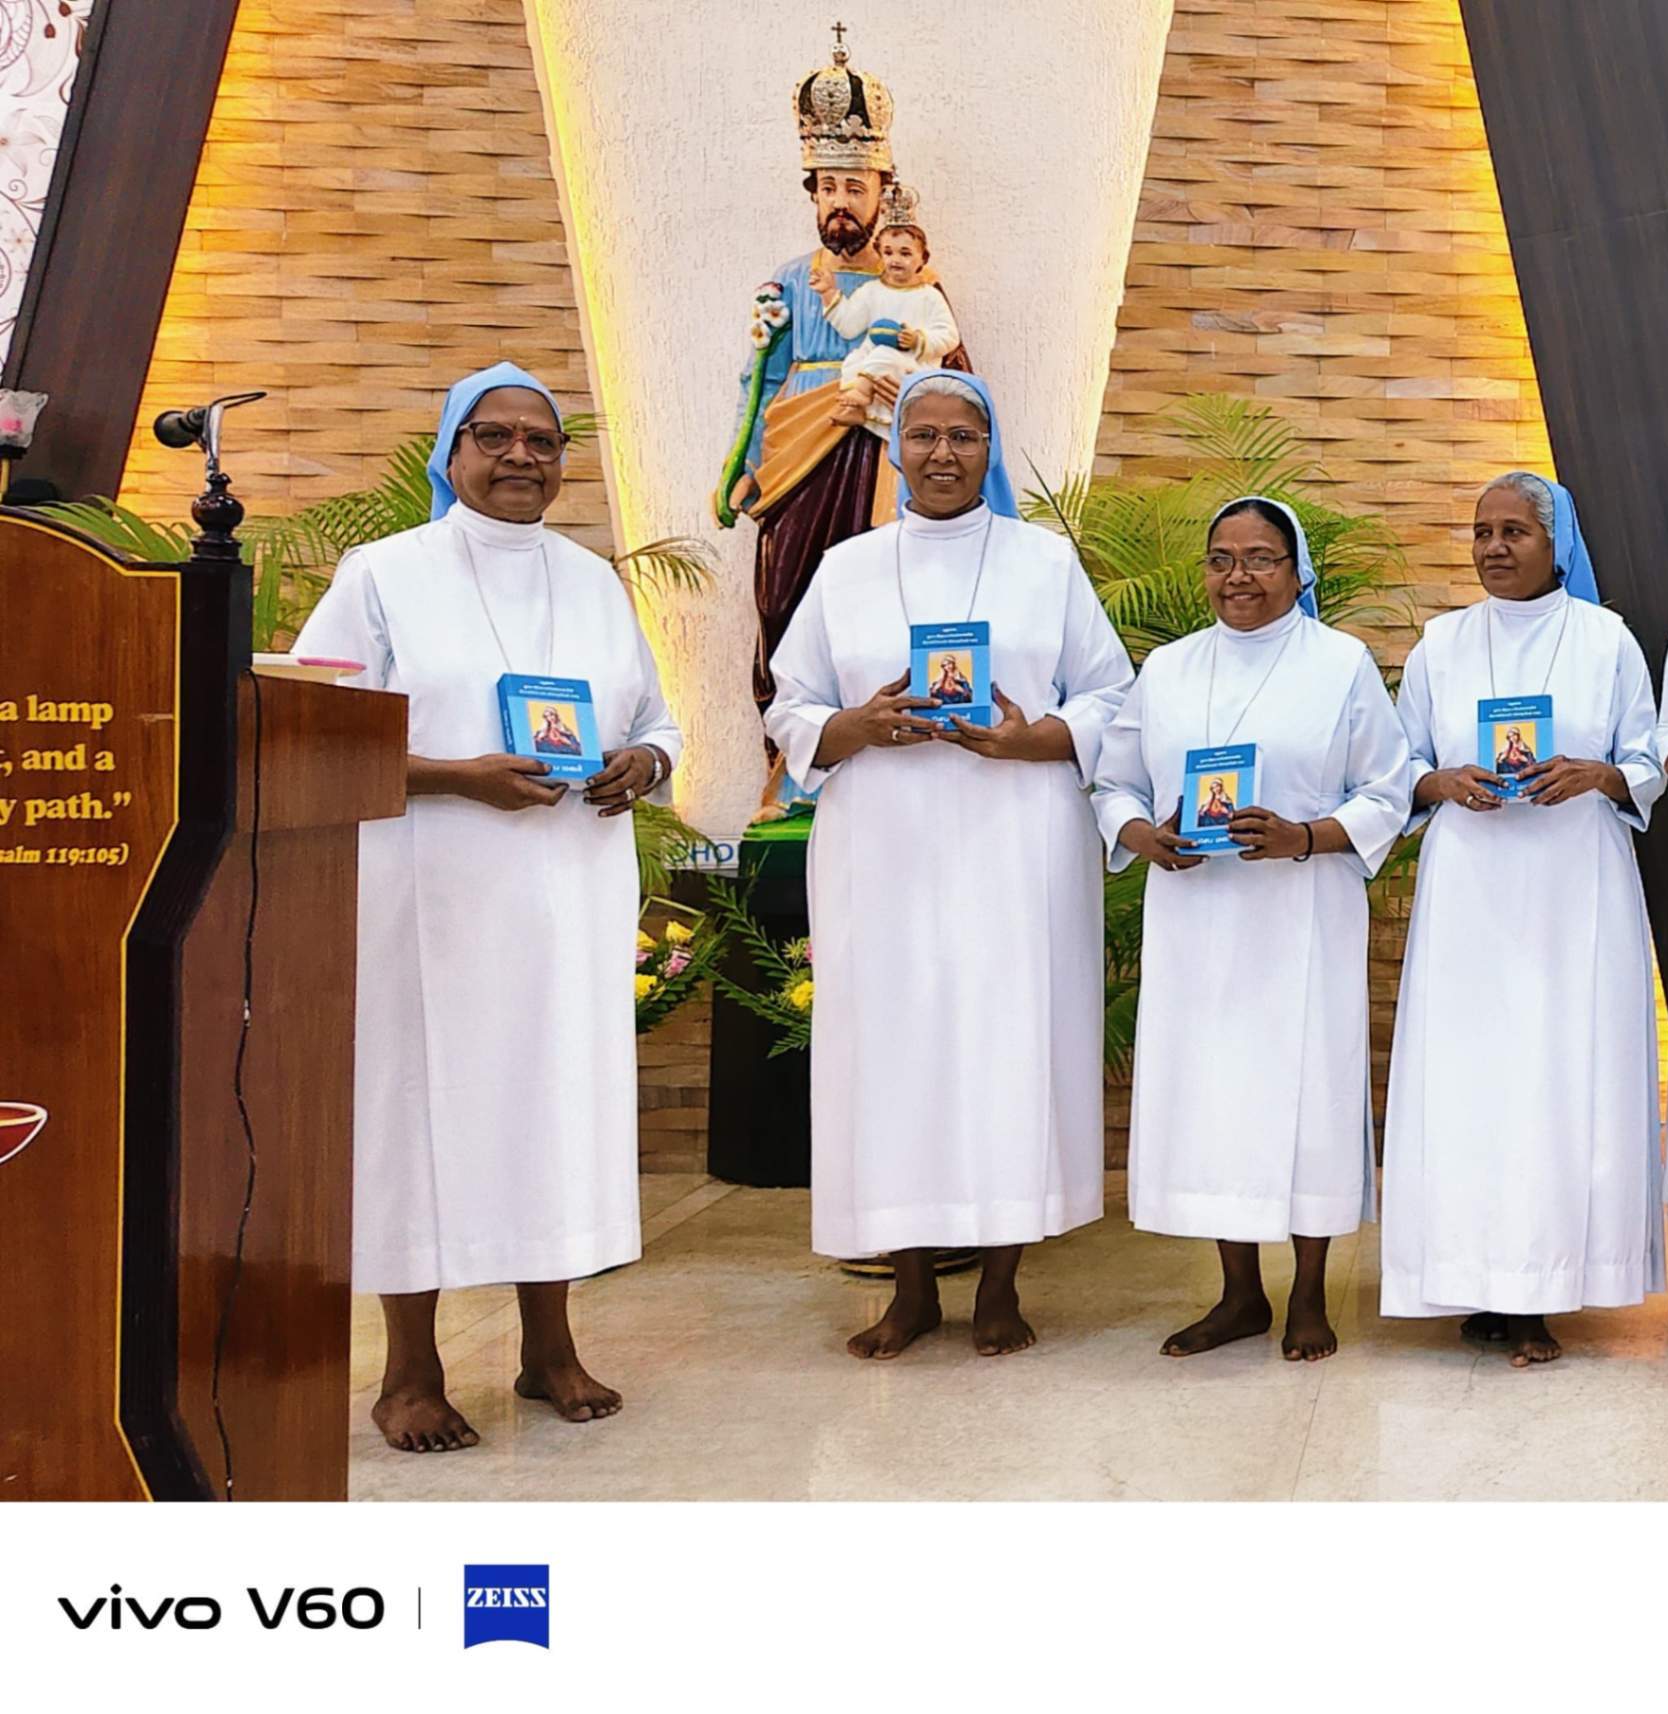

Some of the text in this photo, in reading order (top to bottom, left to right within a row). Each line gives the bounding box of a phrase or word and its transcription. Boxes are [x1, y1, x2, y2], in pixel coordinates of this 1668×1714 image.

[0, 695, 113, 729] a lamp
[22, 744, 86, 770] and
[95, 752, 114, 770] a
[46, 843, 128, 865] 119:105)
